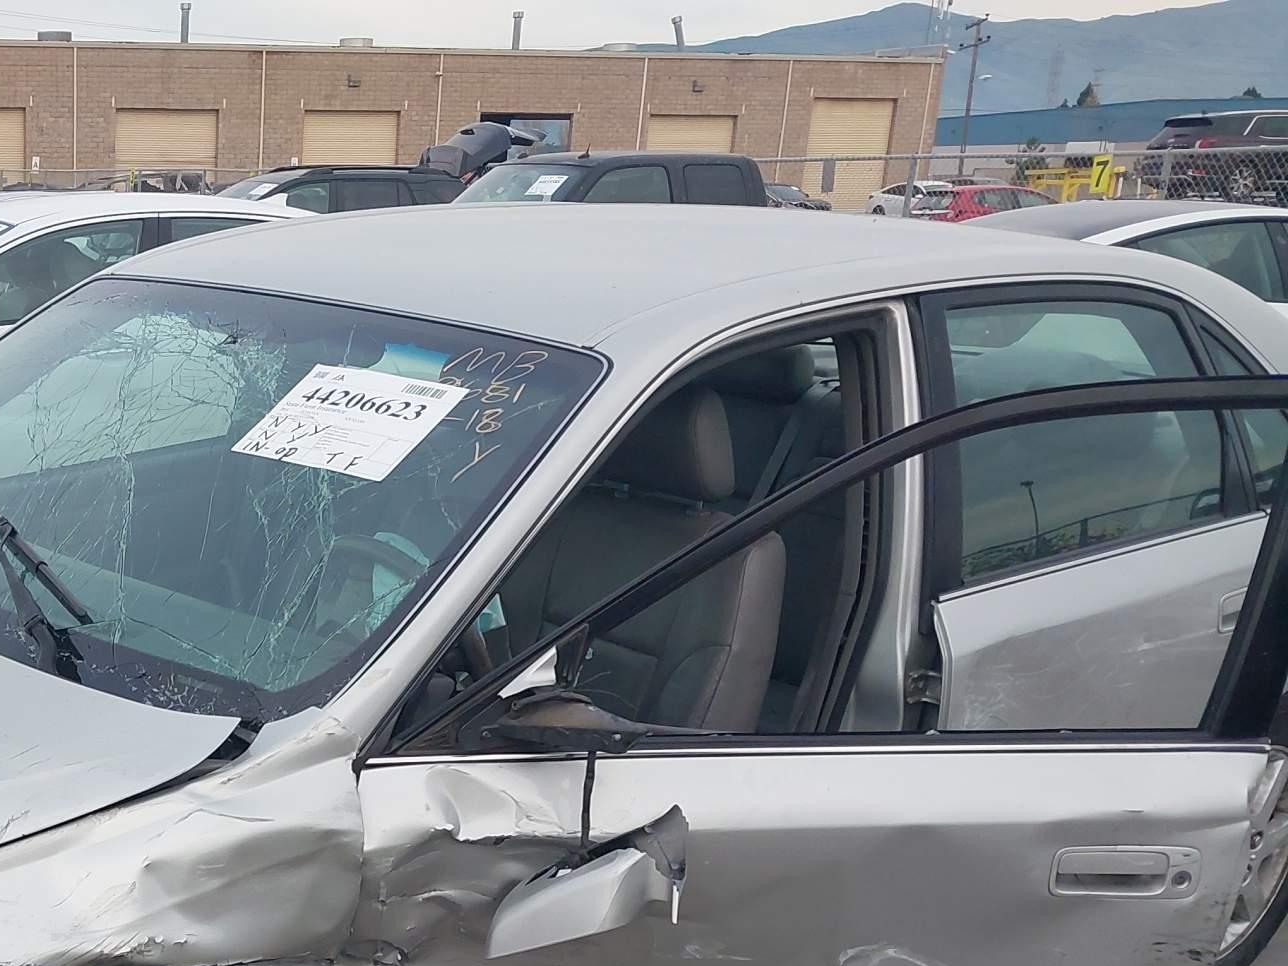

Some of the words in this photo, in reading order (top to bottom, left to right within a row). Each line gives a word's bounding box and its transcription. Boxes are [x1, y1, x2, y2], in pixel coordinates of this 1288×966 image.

[1096, 160, 1110, 187] 7
[301, 386, 428, 421] 44206623
[326, 452, 344, 464] T
